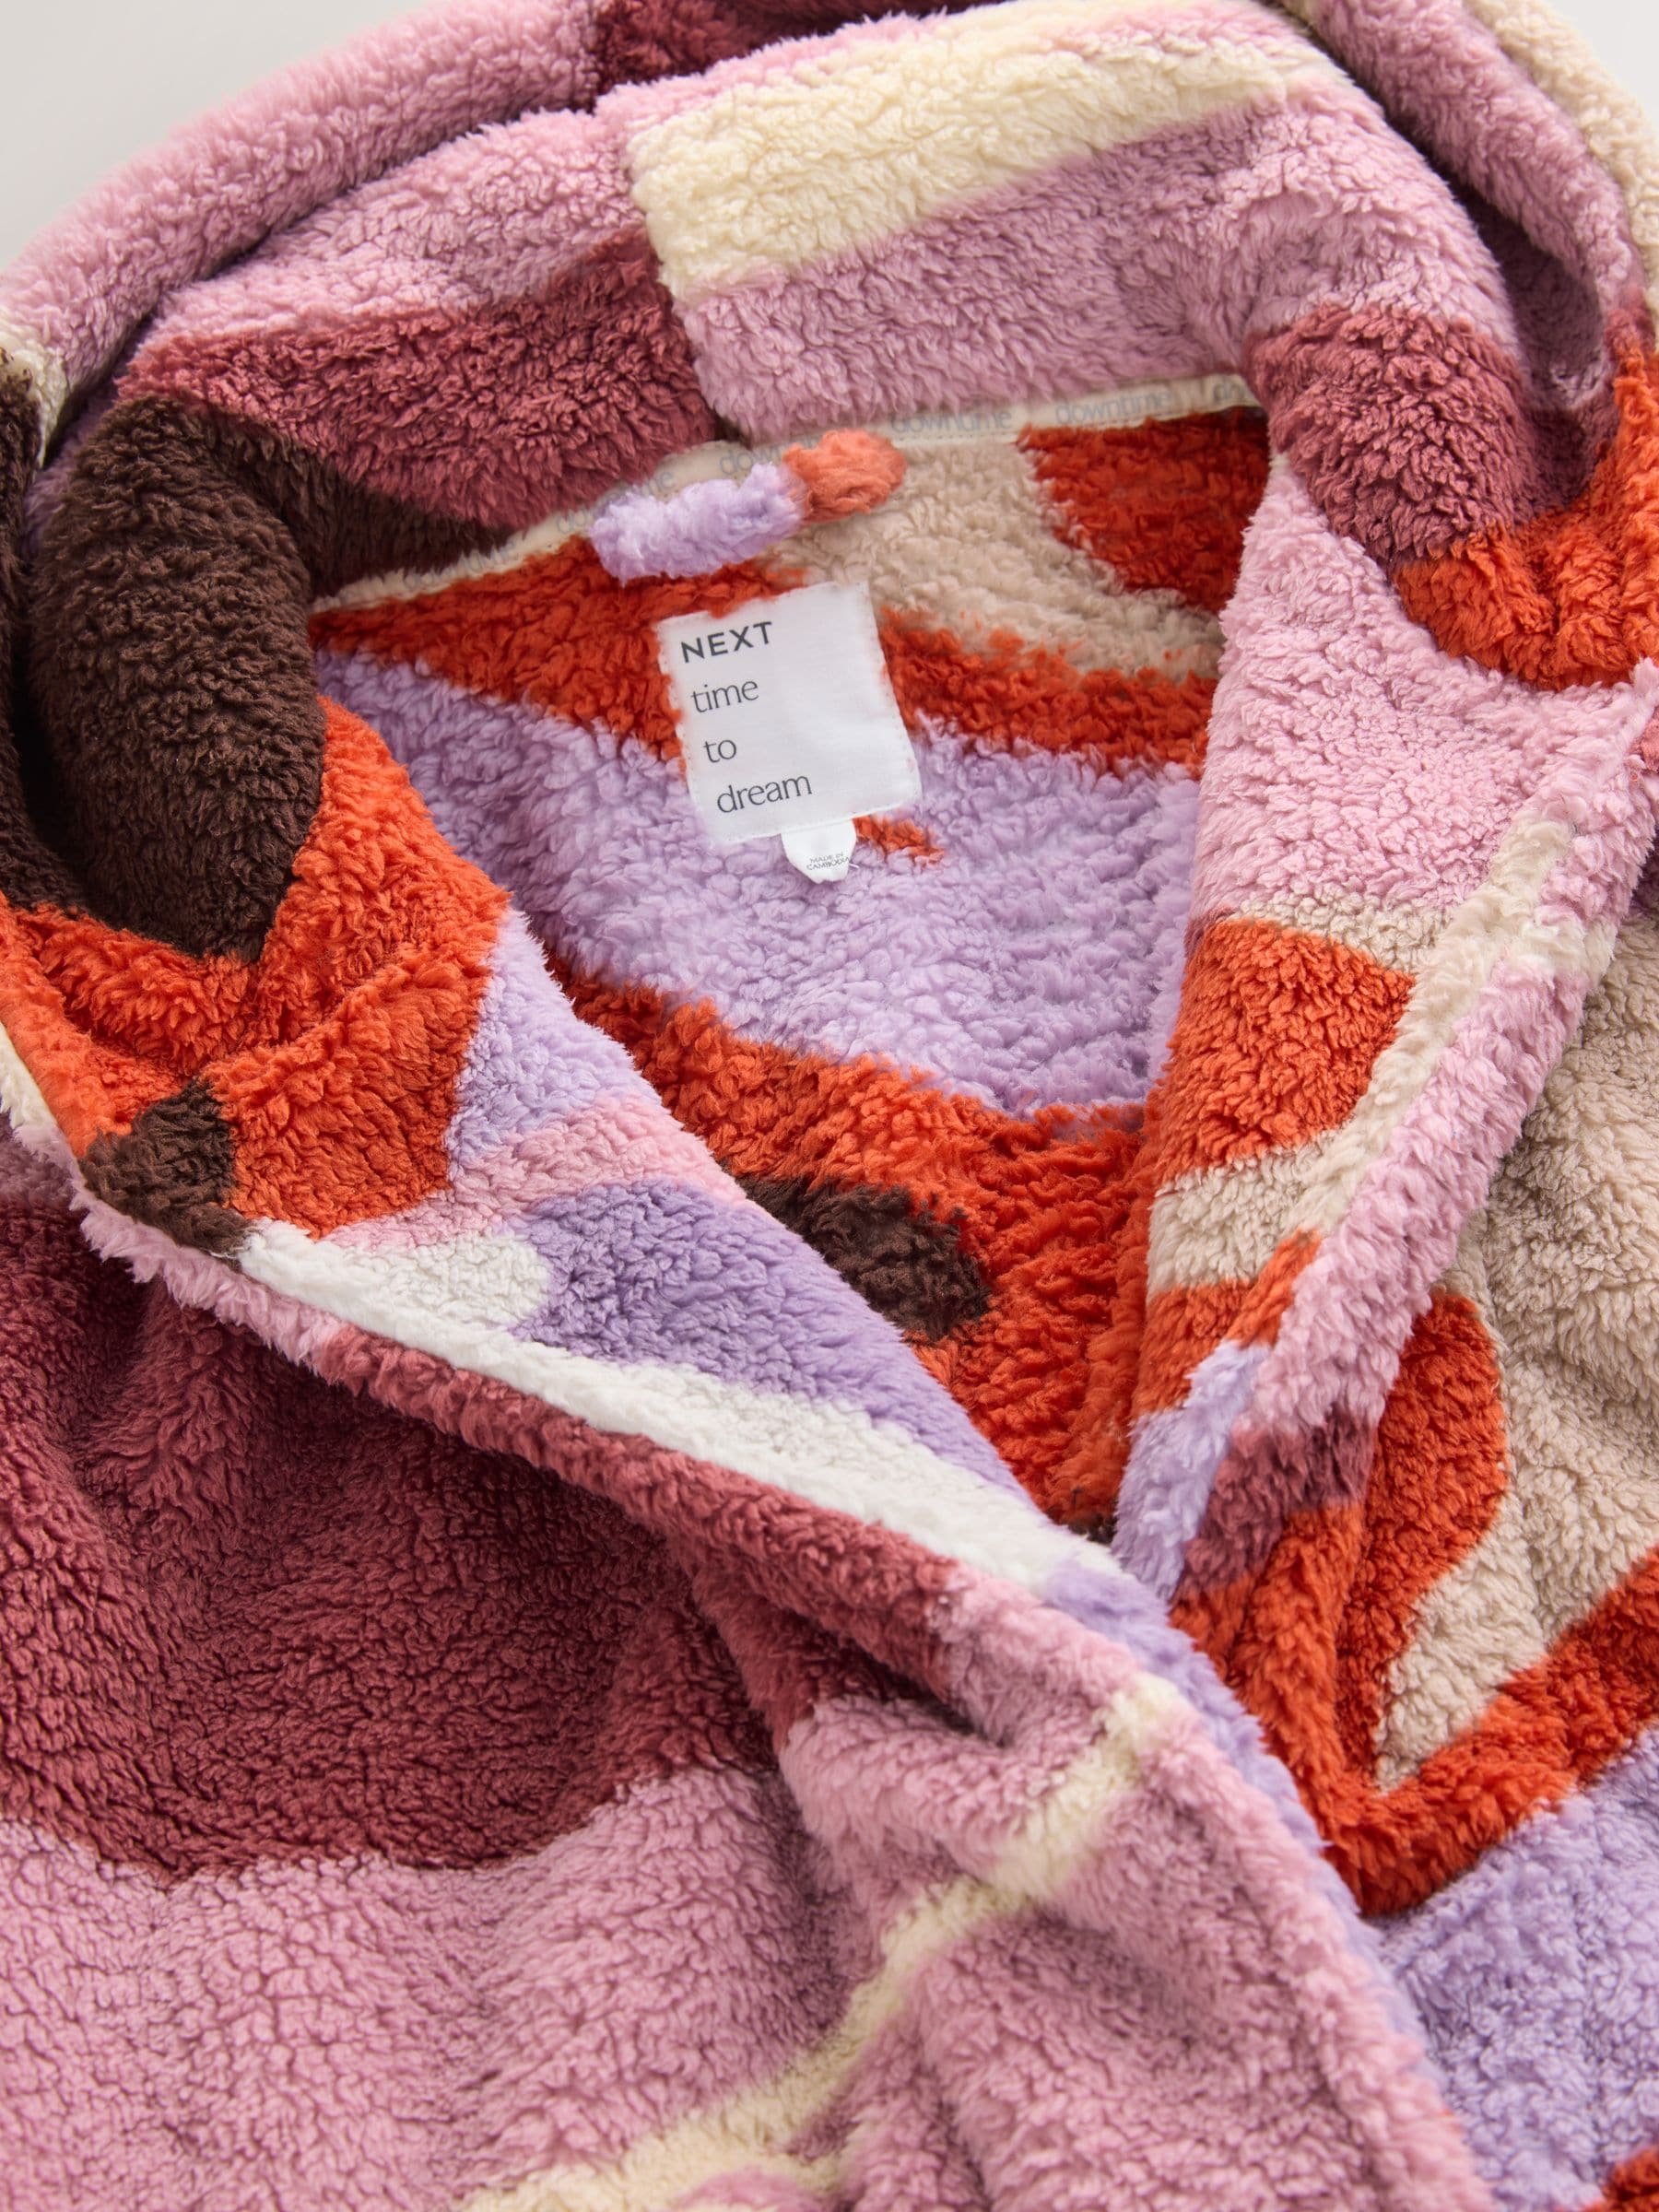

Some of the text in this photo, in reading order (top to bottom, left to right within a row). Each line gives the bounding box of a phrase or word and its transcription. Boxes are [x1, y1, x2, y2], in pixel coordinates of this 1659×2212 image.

[1054, 388, 1171, 425] downtime
[680, 620, 772, 664] NEXT
[690, 679, 760, 713] time
[703, 738, 738, 764] to
[716, 774, 813, 814] dream
[806, 856, 850, 871] CAMBODIA
[809, 854, 833, 864] MADE
